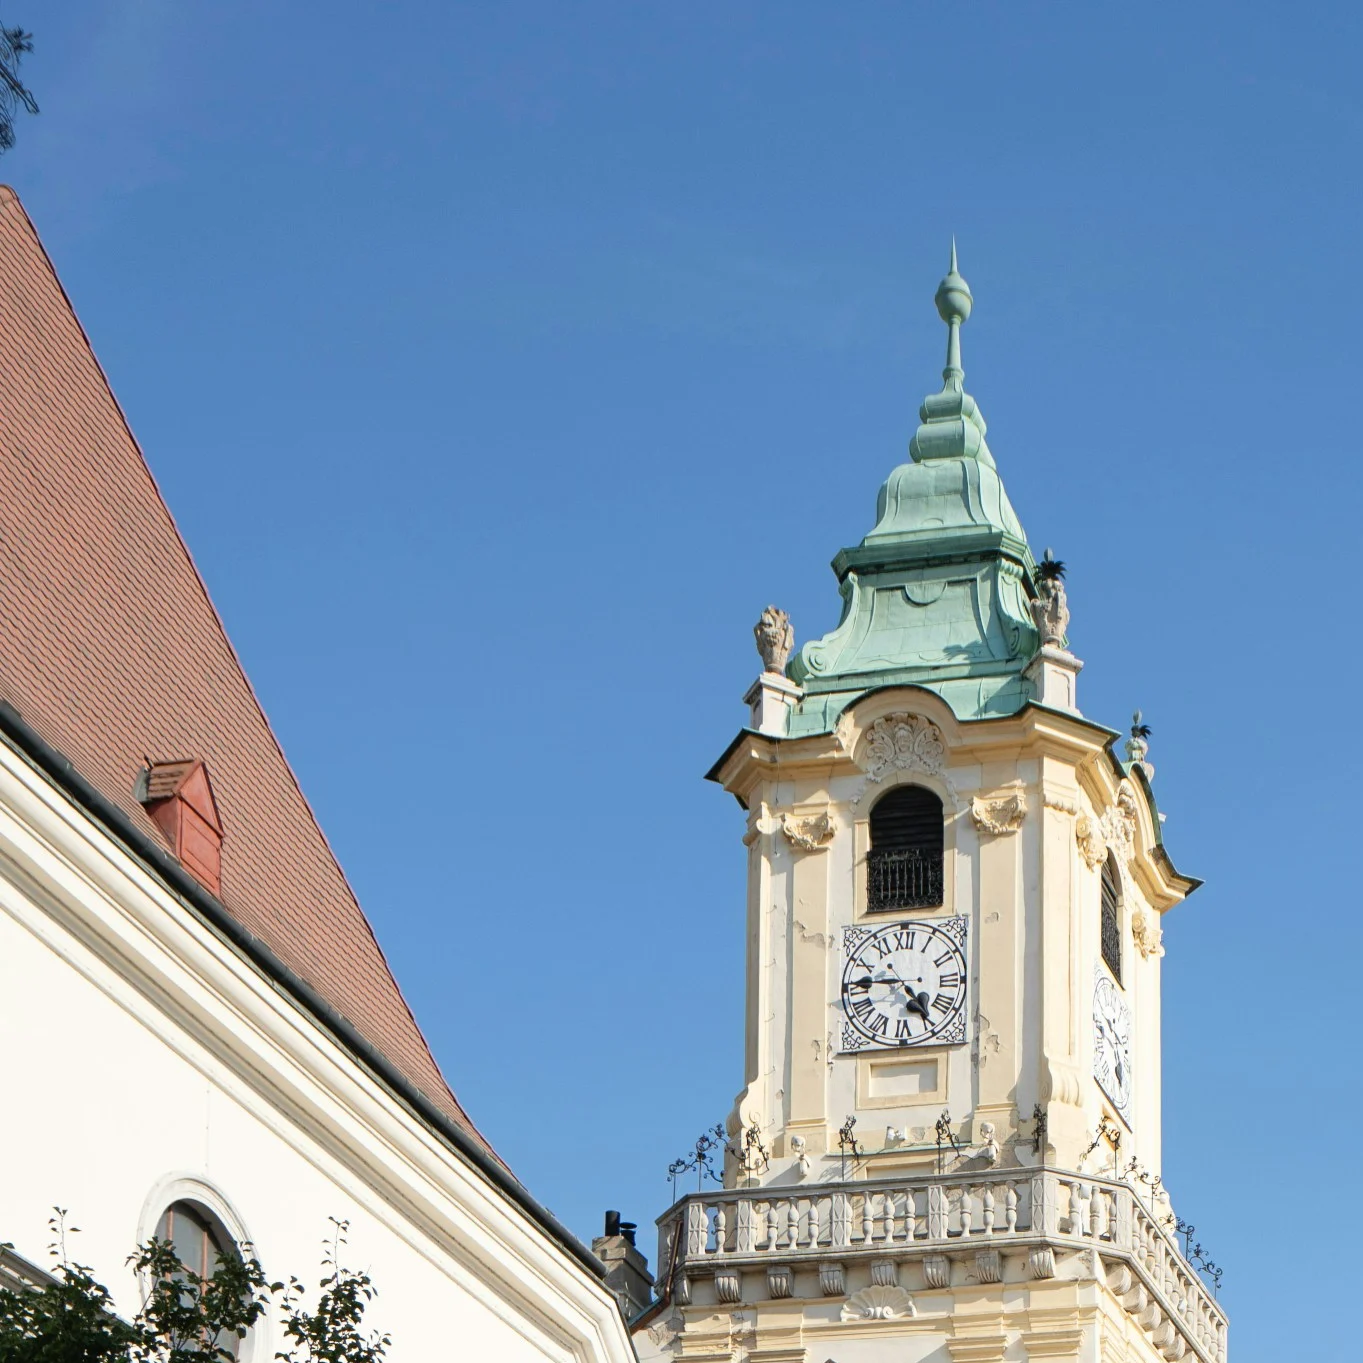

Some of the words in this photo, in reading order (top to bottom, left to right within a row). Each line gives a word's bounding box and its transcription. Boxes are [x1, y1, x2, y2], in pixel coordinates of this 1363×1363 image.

[871, 936, 892, 960] XI
[893, 931, 916, 952] XII
[855, 957, 876, 974] X
[932, 949, 954, 969] II
[939, 971, 959, 989] III
[894, 1018, 912, 1038] VI
